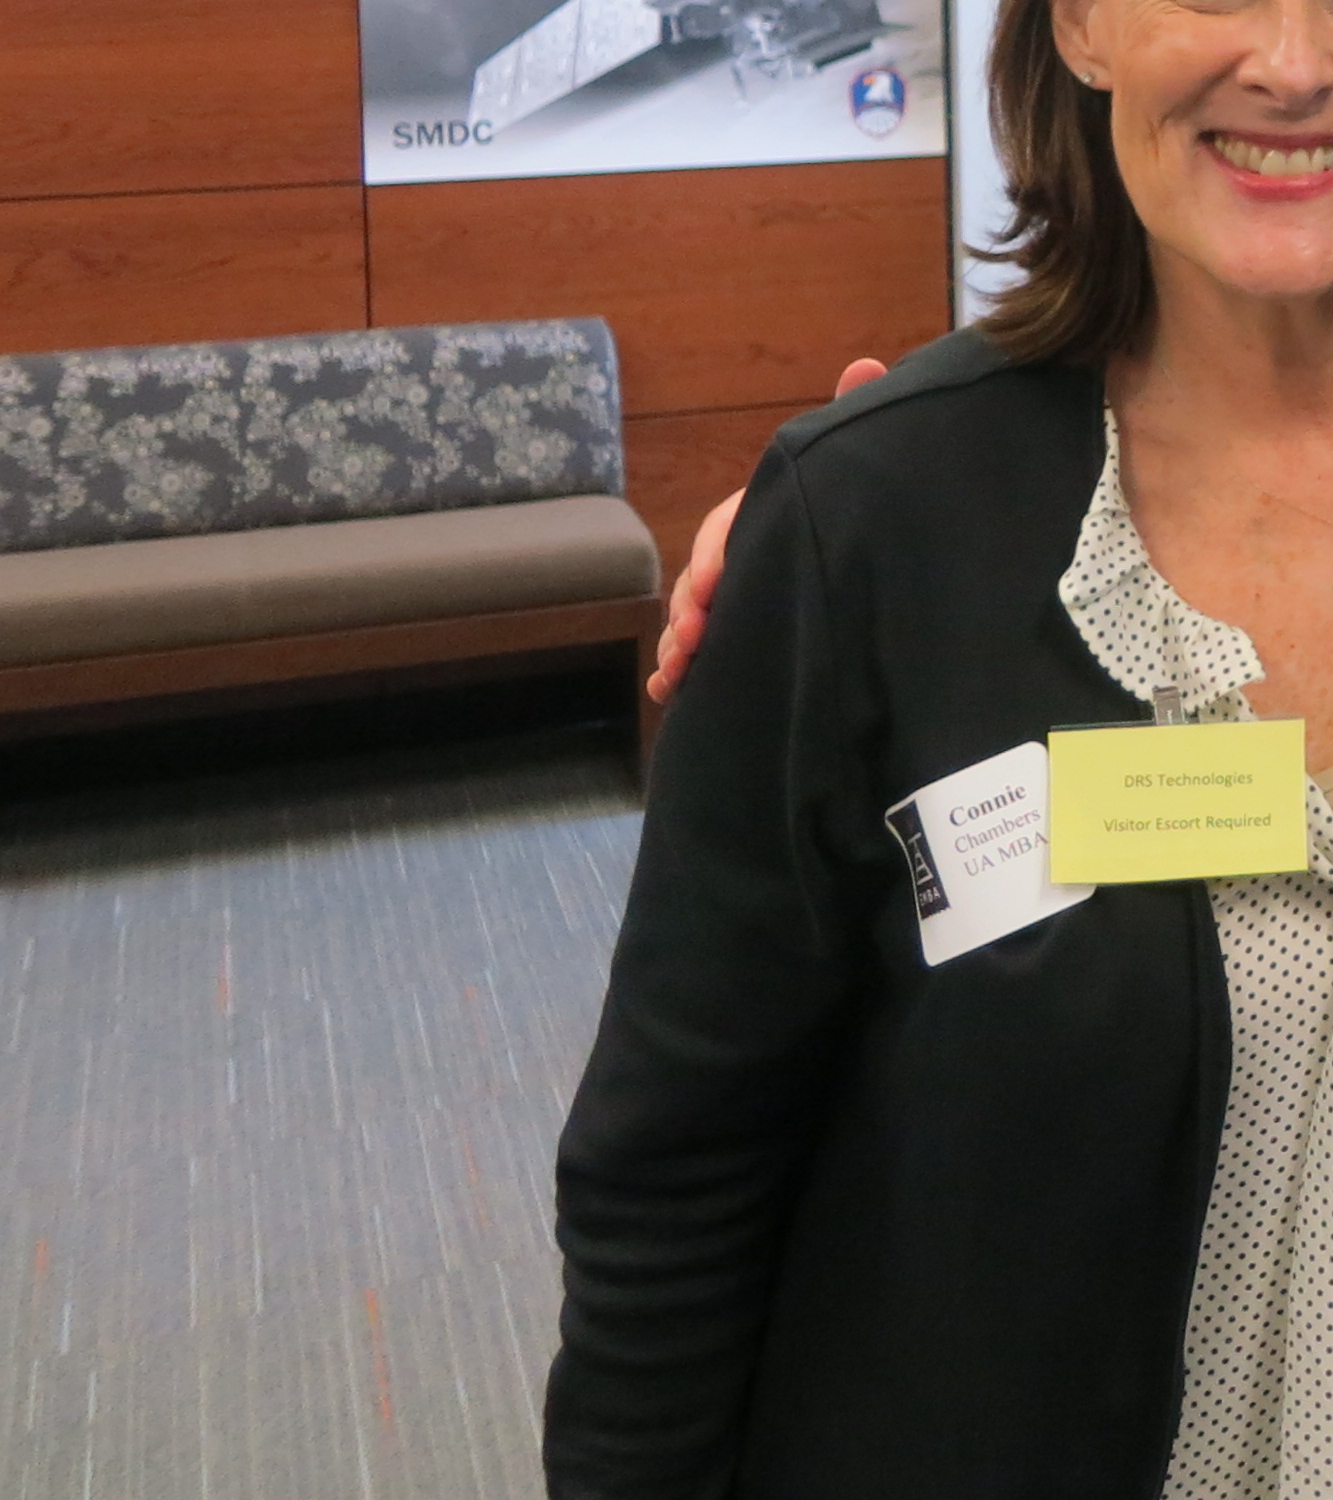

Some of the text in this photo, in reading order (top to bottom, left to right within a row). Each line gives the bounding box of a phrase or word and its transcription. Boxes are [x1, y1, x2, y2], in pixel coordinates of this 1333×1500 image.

[393, 120, 494, 150] SMDC
[1124, 771, 1253, 788] DRS Technologies
[949, 785, 1027, 827] Connie
[1103, 813, 1272, 832] Visitor Escort Required
[954, 809, 1041, 854] Chambers
[963, 830, 1049, 877] UA MBA
